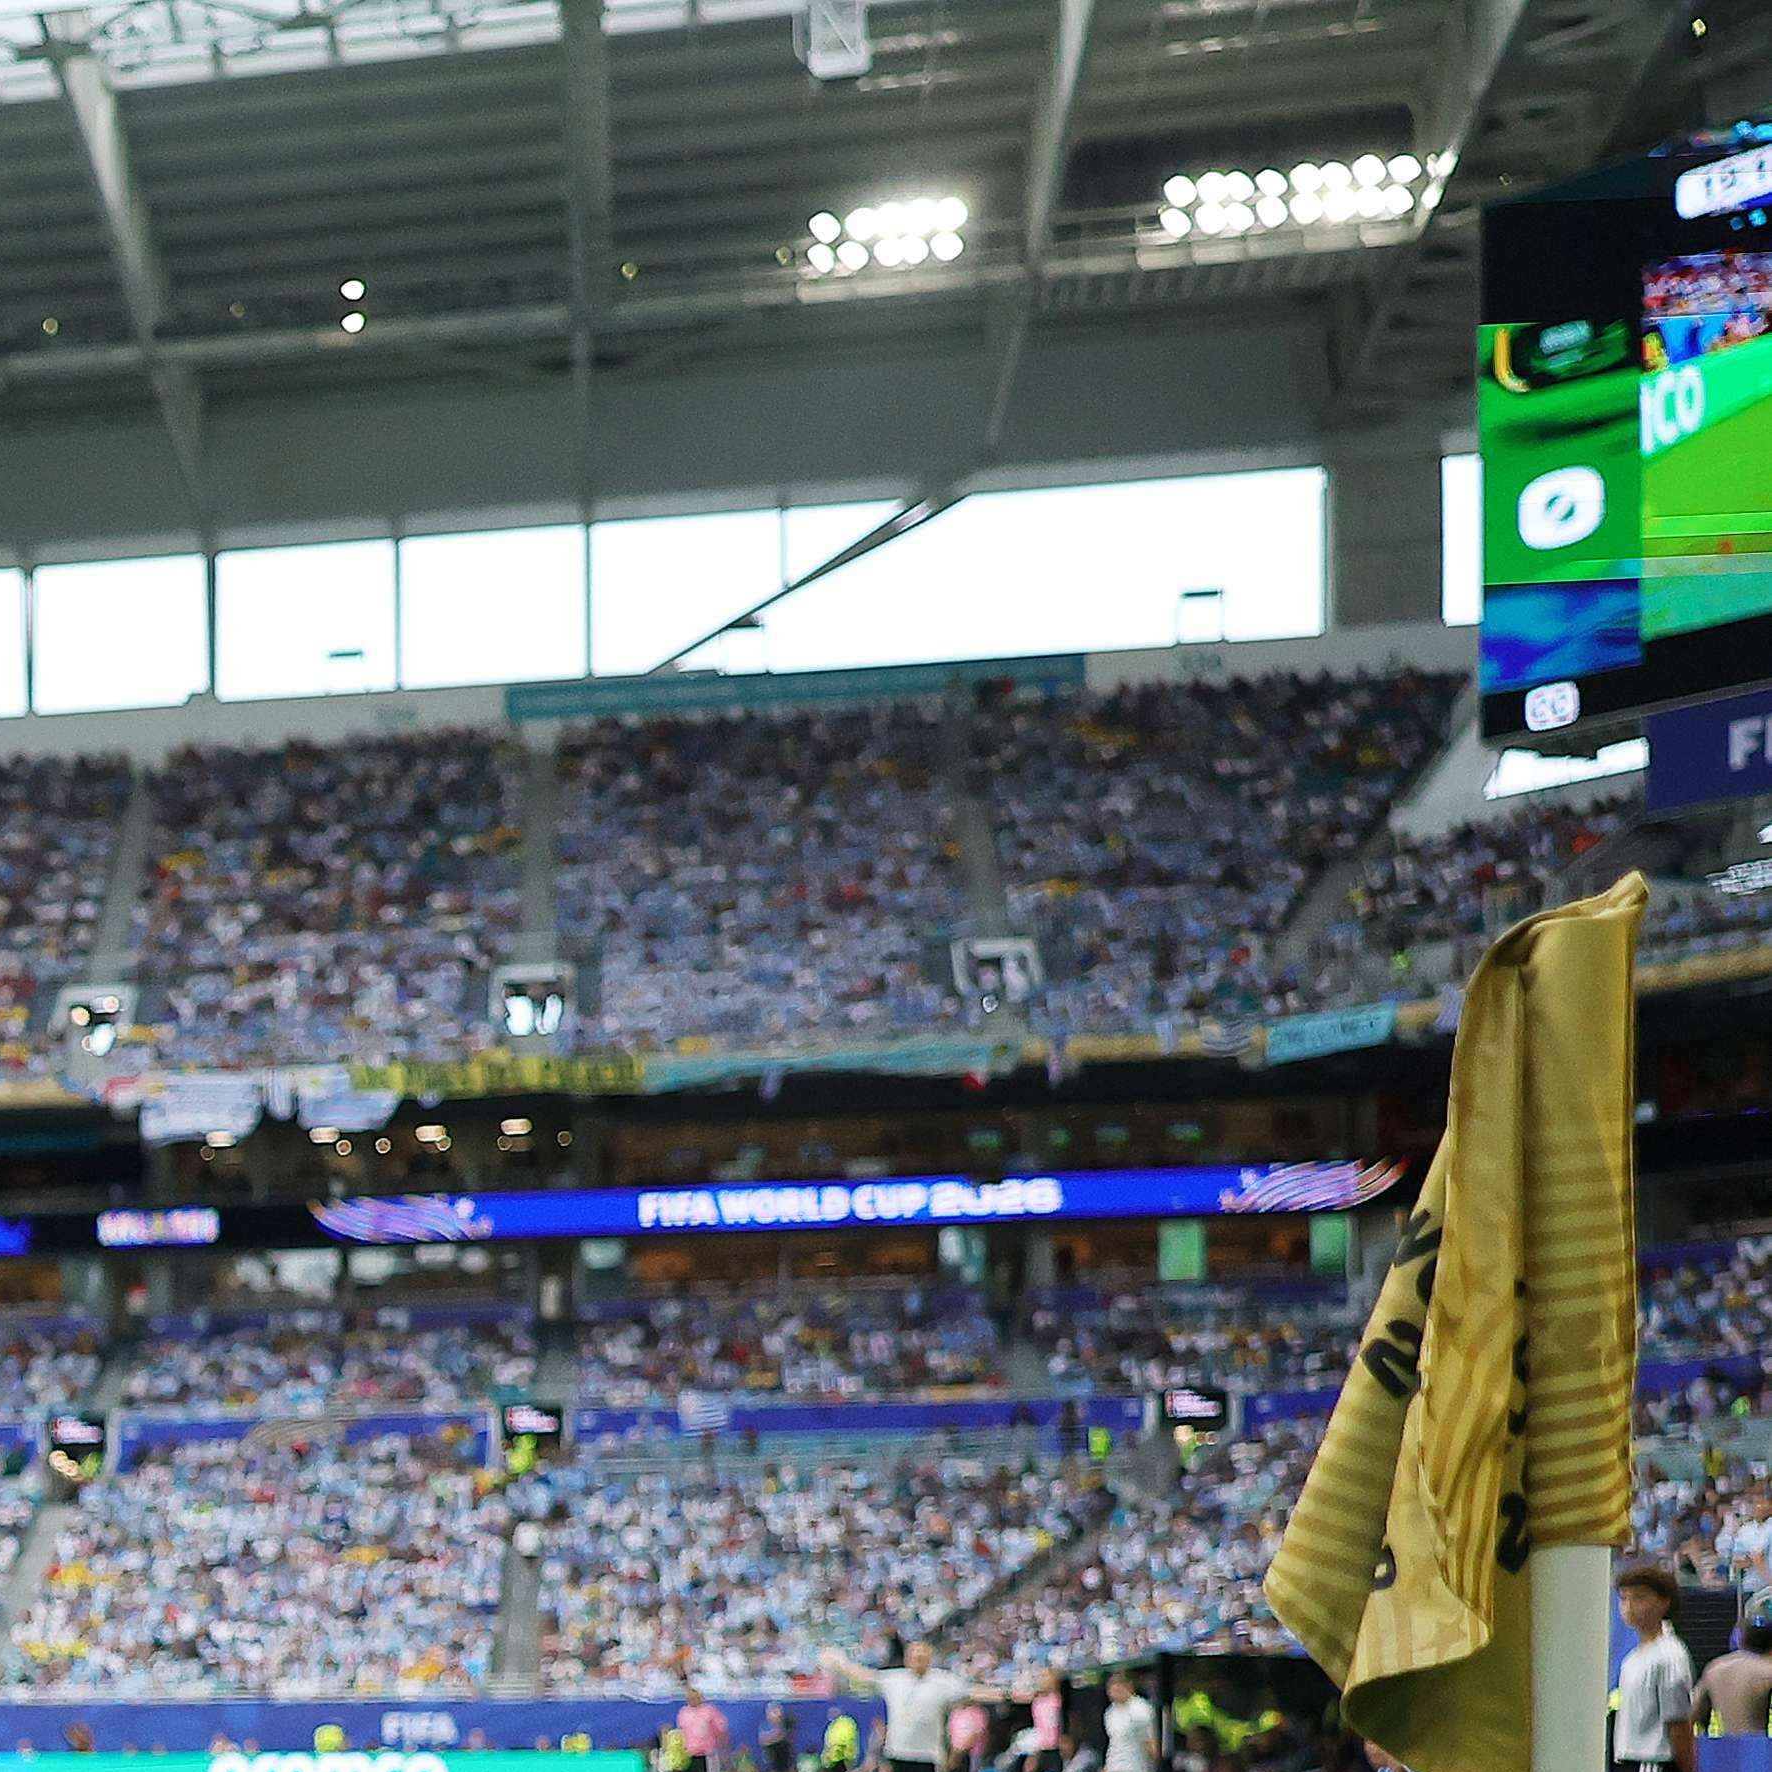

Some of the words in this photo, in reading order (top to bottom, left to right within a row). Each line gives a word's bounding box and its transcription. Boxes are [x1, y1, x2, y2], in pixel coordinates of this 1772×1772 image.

[638, 1191, 718, 1228] FIFA
[718, 1186, 851, 1224] WORLD
[852, 1183, 929, 1220] CUP
